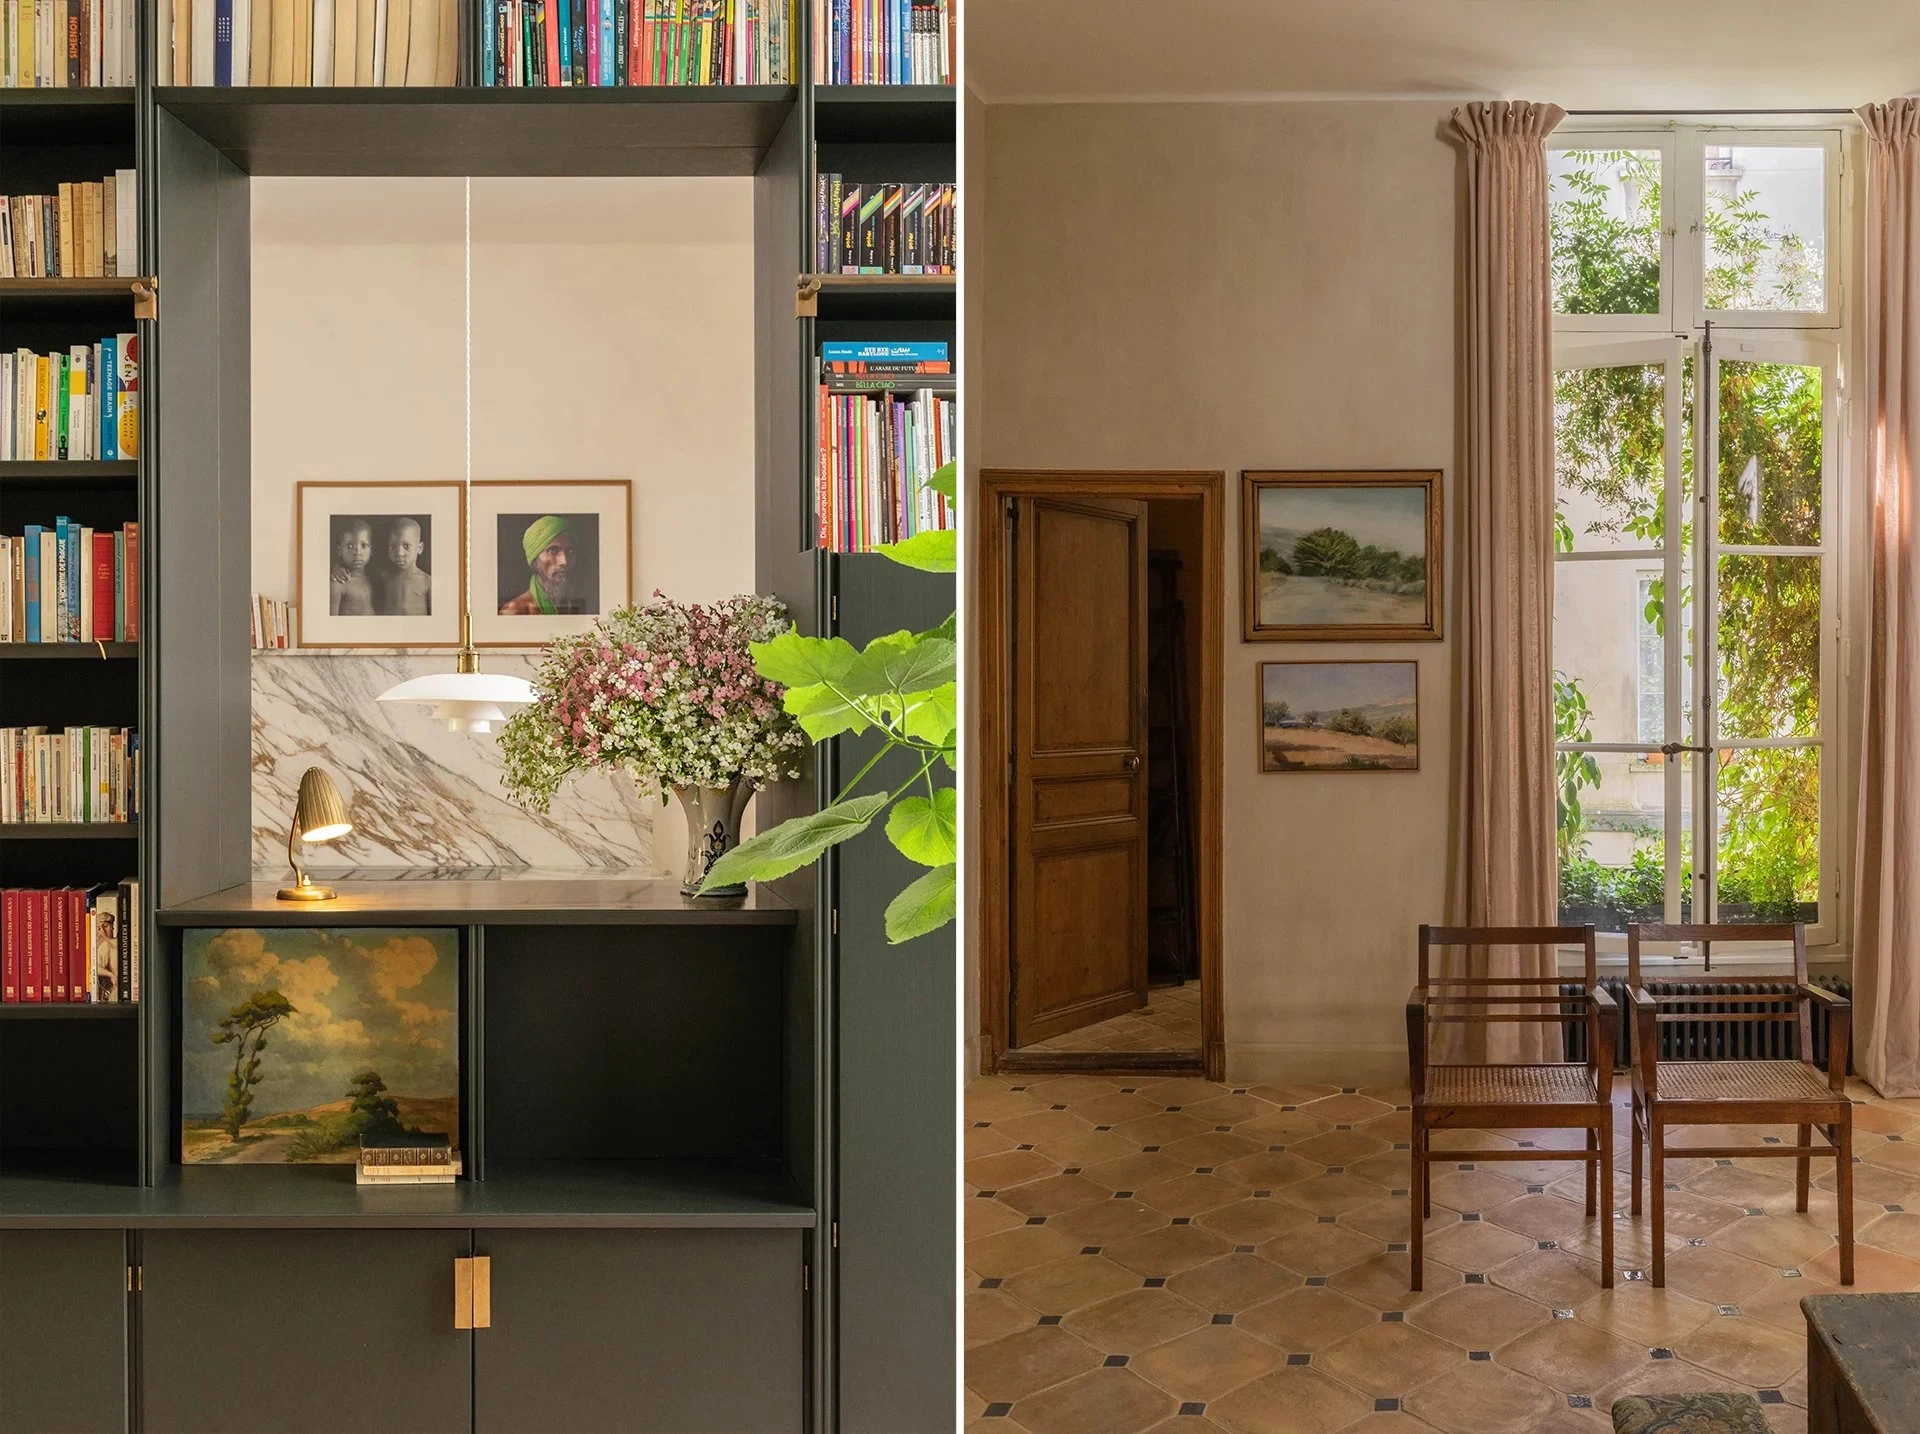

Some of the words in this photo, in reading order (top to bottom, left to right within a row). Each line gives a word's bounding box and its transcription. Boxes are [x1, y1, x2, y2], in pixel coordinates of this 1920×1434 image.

[68, 15, 78, 59] SIMENON
[124, 354, 132, 385] GENE
[855, 381, 875, 389] BELLA
[875, 381, 895, 389] CIAO
[820, 481, 828, 490] tu
[819, 490, 829, 524] pourquoi
